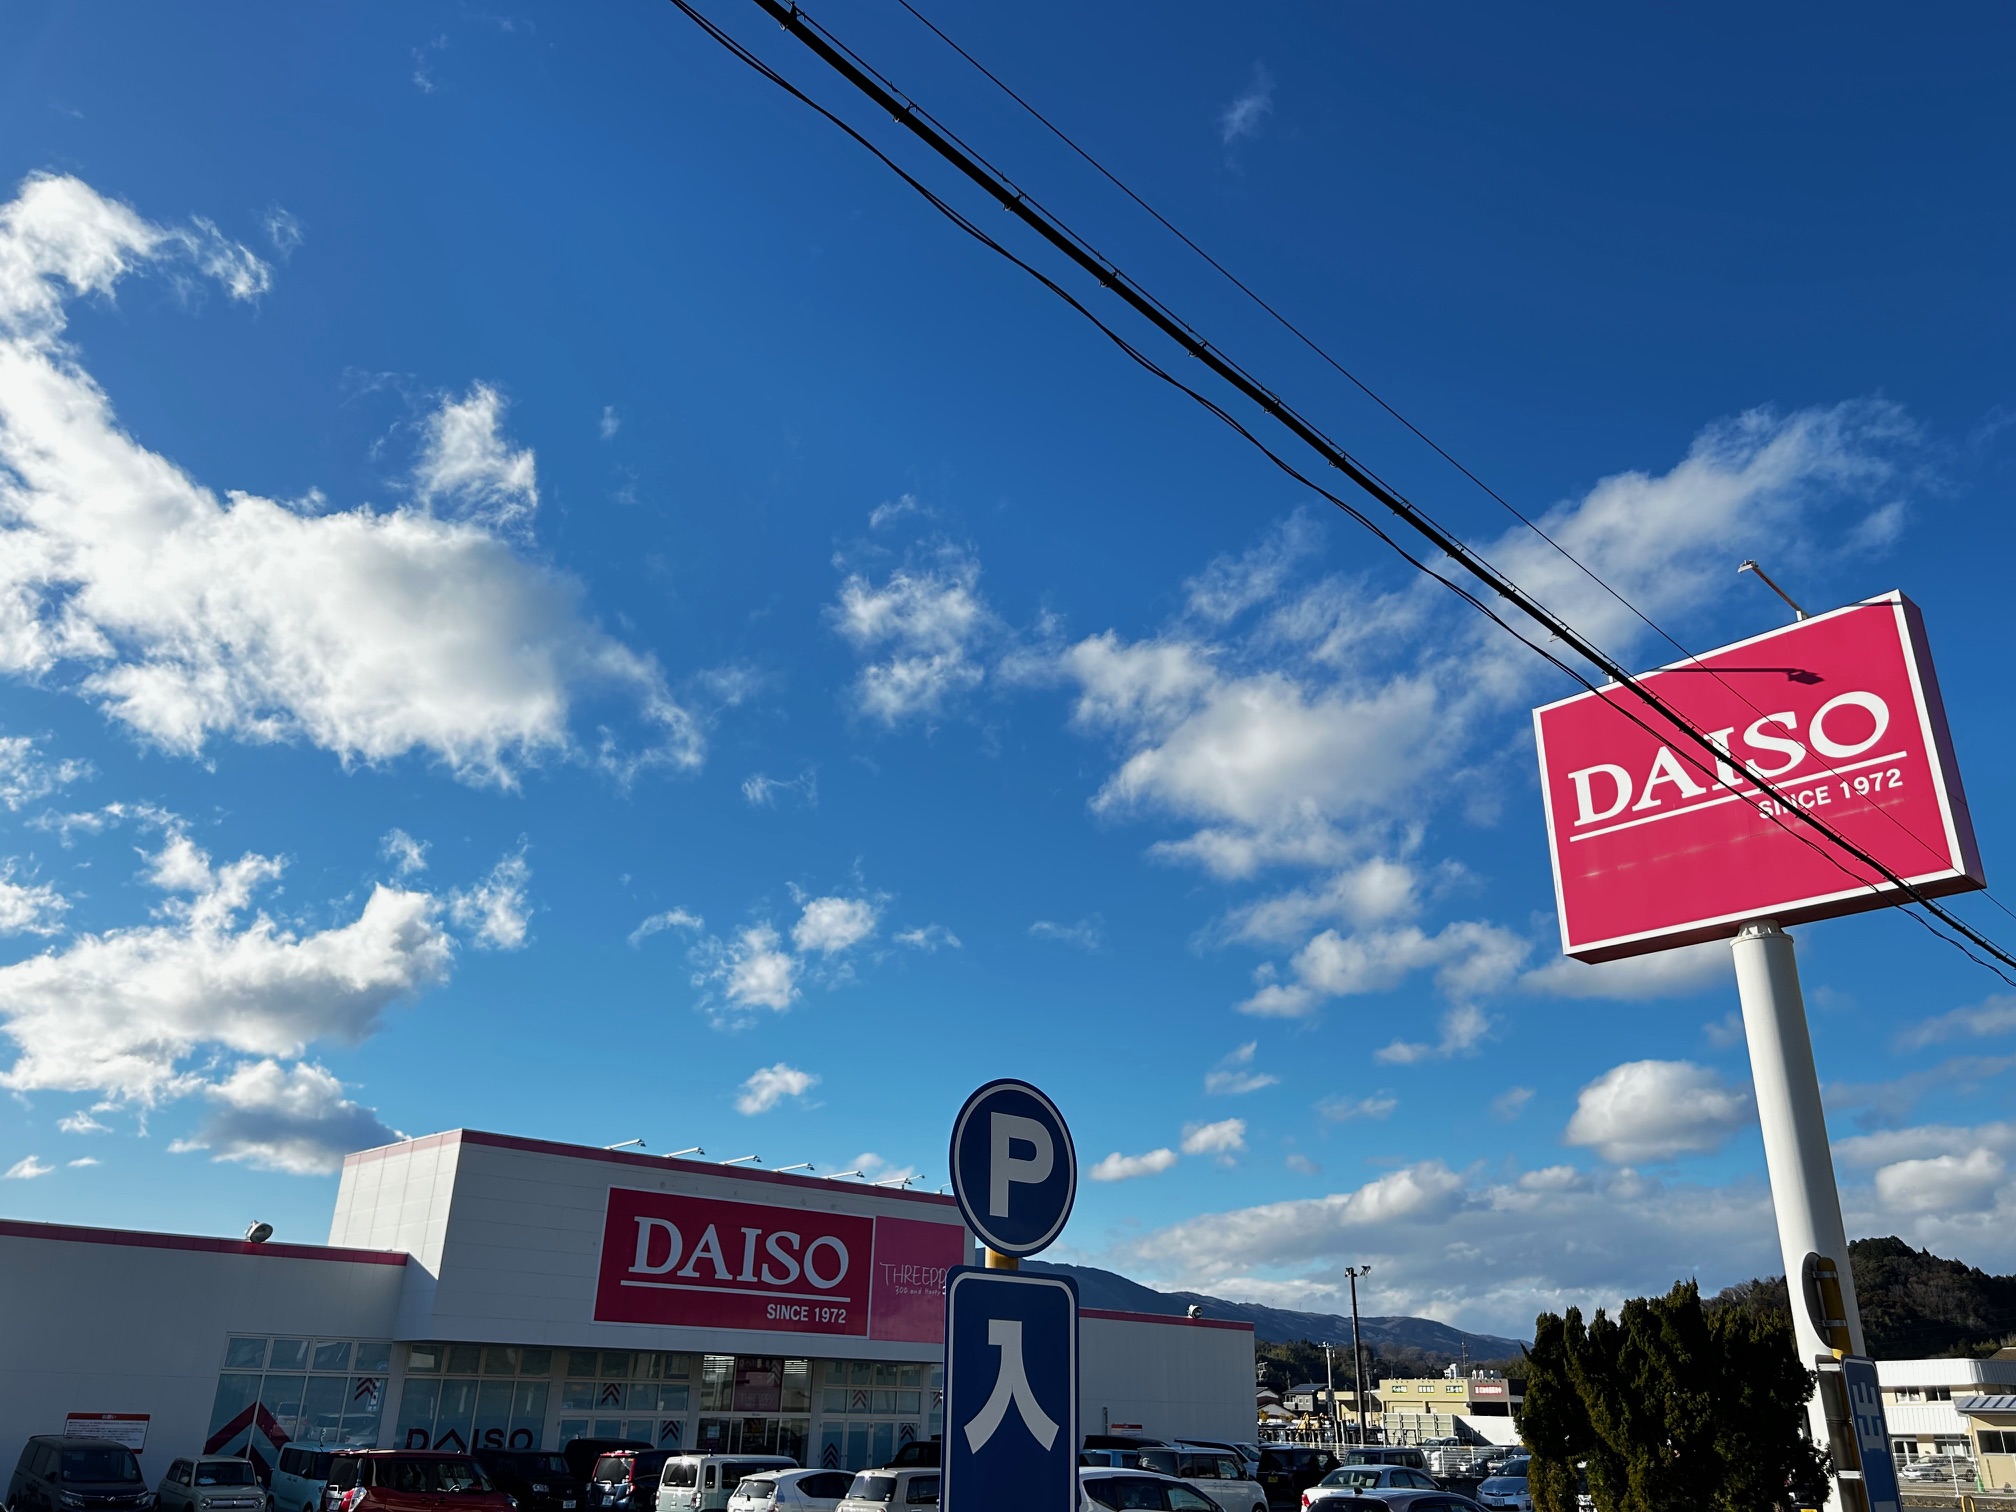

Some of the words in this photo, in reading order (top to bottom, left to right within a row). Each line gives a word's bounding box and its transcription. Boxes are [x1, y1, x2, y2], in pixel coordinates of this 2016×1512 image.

[1568, 691, 1889, 826] DAISO
[1839, 768, 1903, 799] 1972
[990, 1112, 1054, 1217] P
[628, 1216, 849, 1289] DAISO
[879, 1262, 946, 1289] THREEPP
[766, 1304, 809, 1322] SINCE
[814, 1307, 847, 1324] 1972
[964, 1319, 1059, 1454] 入
